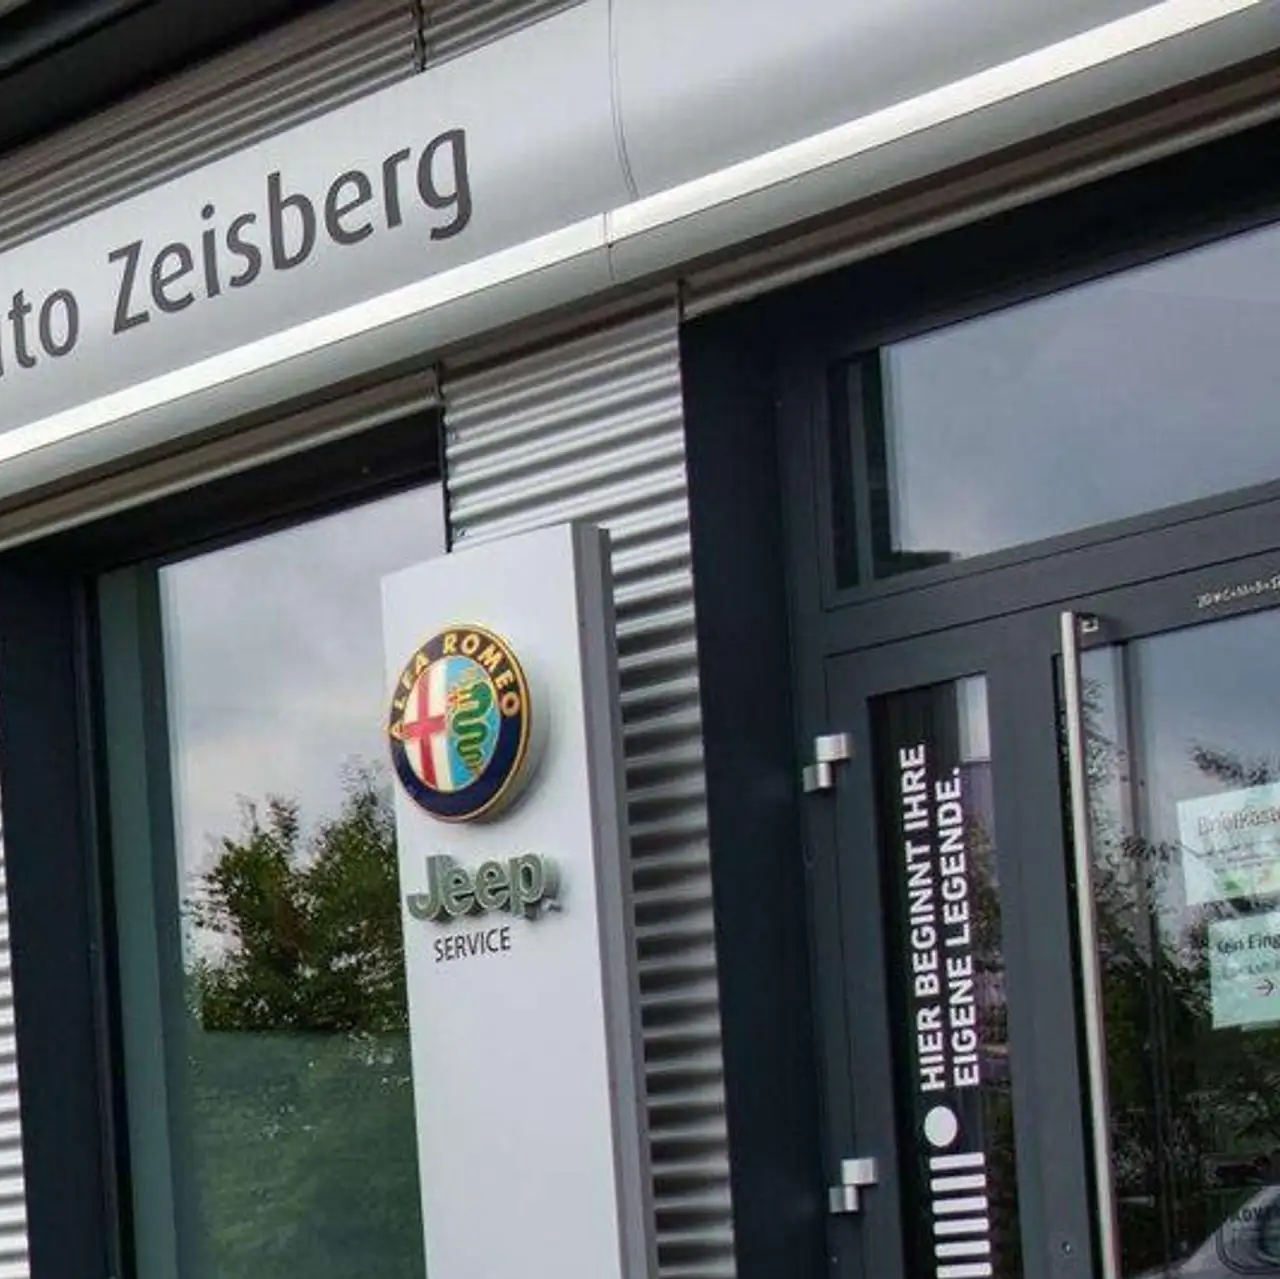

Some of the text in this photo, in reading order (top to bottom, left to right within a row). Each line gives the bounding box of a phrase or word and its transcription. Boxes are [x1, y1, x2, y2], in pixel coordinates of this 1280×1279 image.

[108, 129, 474, 335] Zeisberg
[443, 632, 522, 719] ROMEO
[406, 854, 546, 922] Jeep
[434, 927, 511, 963] SERVICE
[899, 743, 945, 1093] HIER BEGINNT IHRE
[935, 766, 979, 1089] EIGENE LEGENDE.
